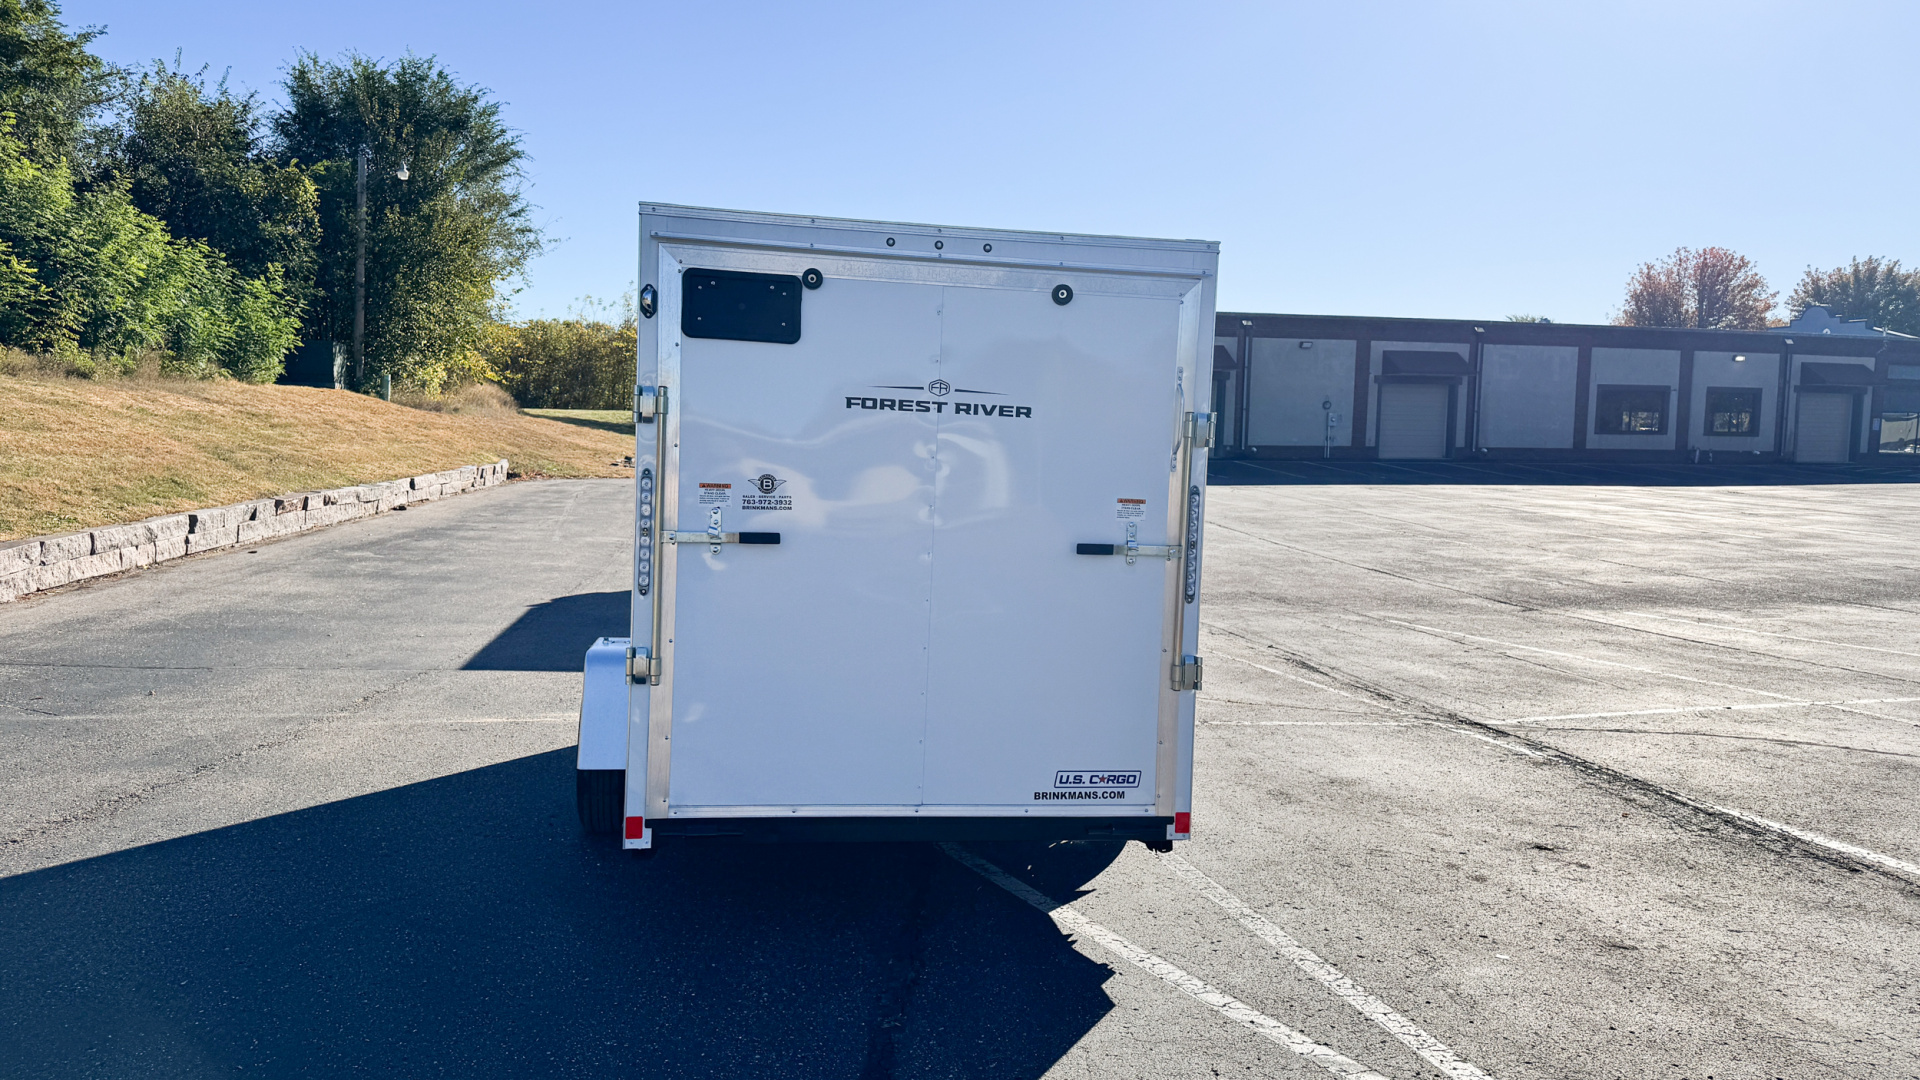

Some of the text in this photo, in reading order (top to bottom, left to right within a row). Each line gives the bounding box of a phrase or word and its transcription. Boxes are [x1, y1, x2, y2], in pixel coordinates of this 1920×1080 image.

[845, 396, 1032, 418] FOREST RIVER
[763, 479, 772, 489] B
[1059, 774, 1086, 784] U.S.
[1034, 790, 1125, 800] BRINKMANS.COM
